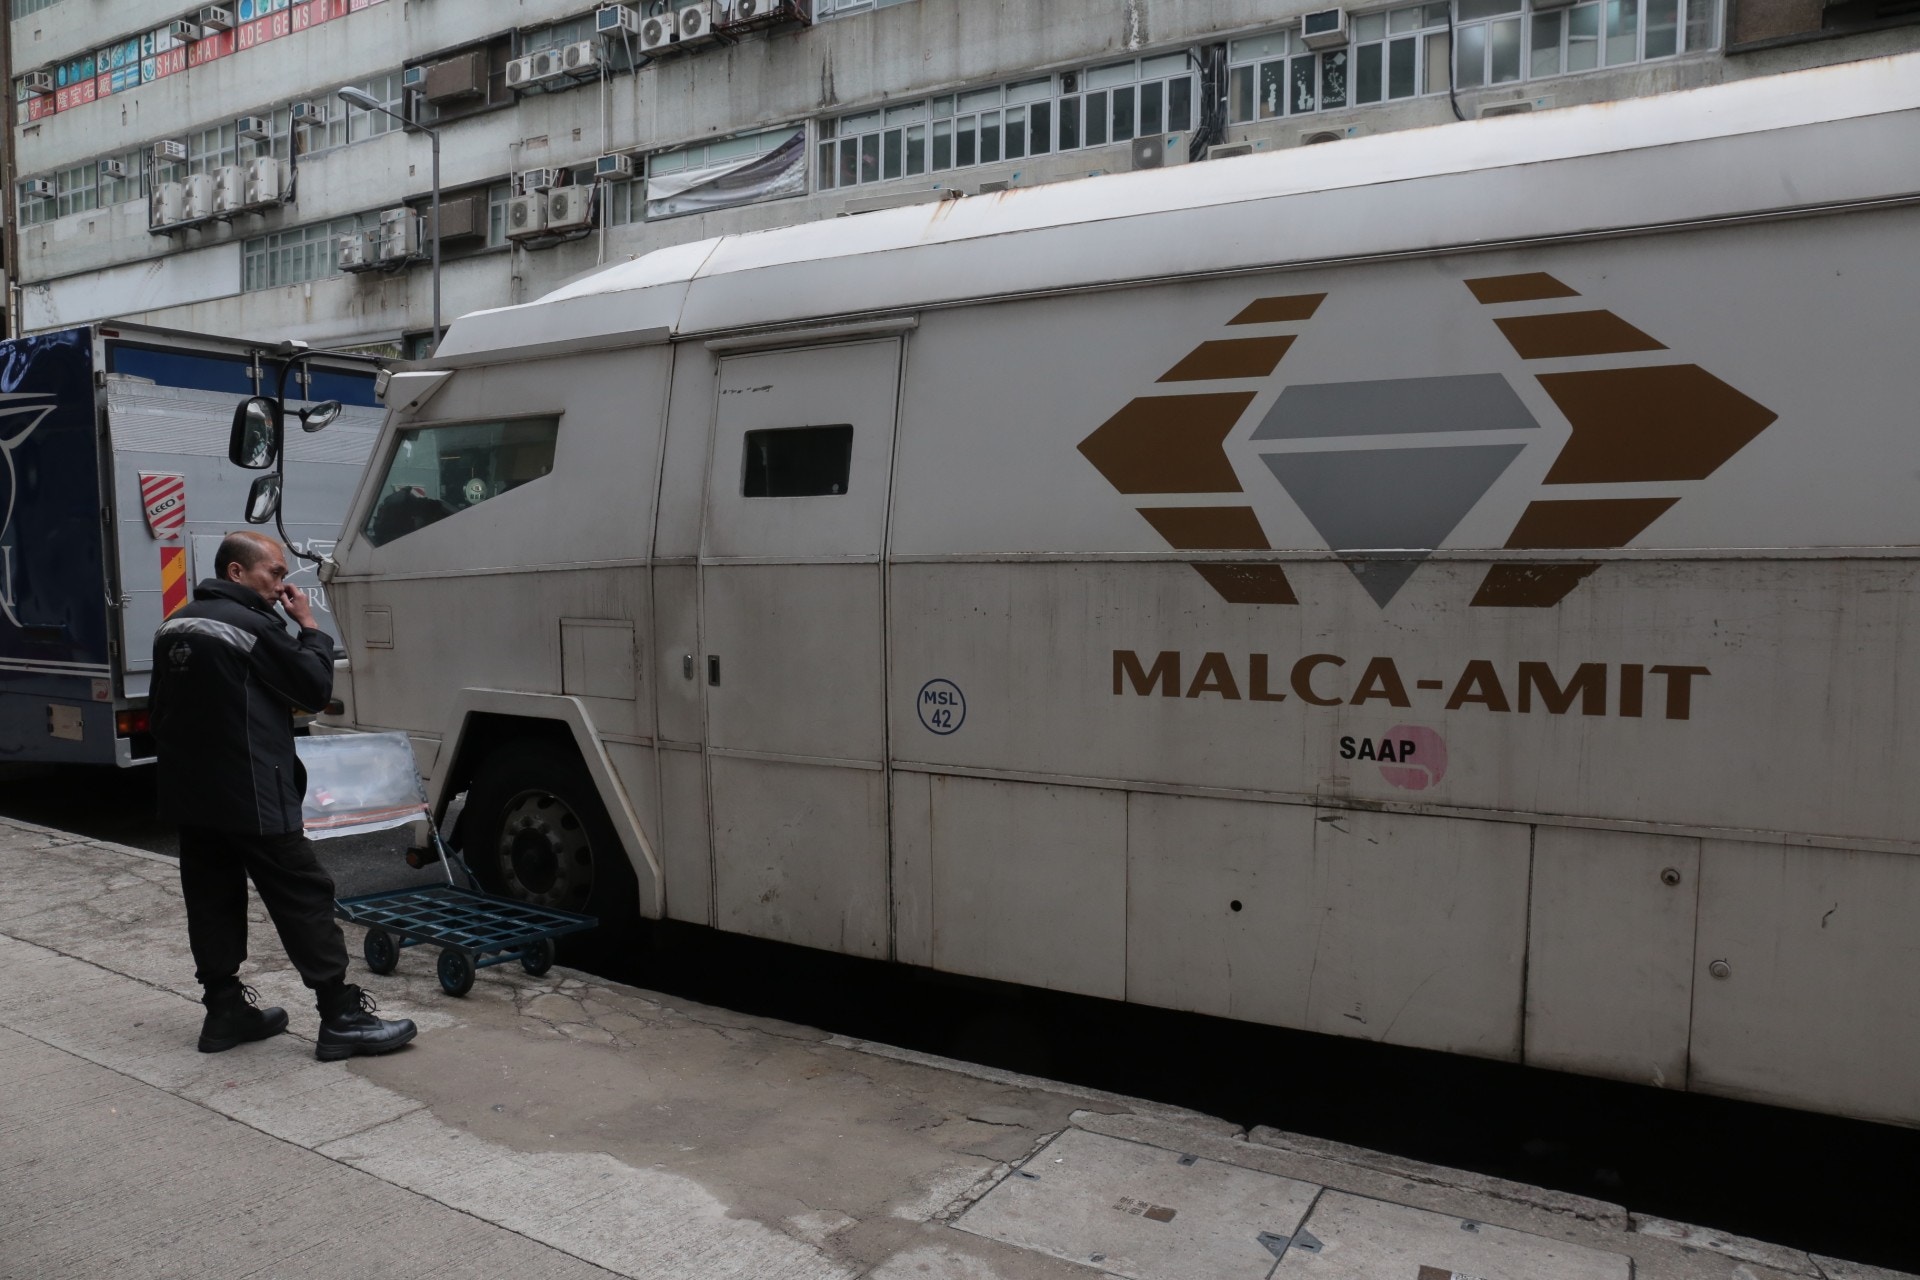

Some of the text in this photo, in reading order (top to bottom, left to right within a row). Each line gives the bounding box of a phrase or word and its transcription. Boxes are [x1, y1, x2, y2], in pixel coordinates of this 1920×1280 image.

[156, 37, 218, 73] SHANGHAI
[230, 22, 263, 52] JADE
[273, 6, 309, 36] GEMS
[924, 690, 958, 706] MSL
[1112, 649, 1712, 720] MALCA-AMIT
[931, 708, 952, 728] 42
[1339, 736, 1416, 763] SAAP
